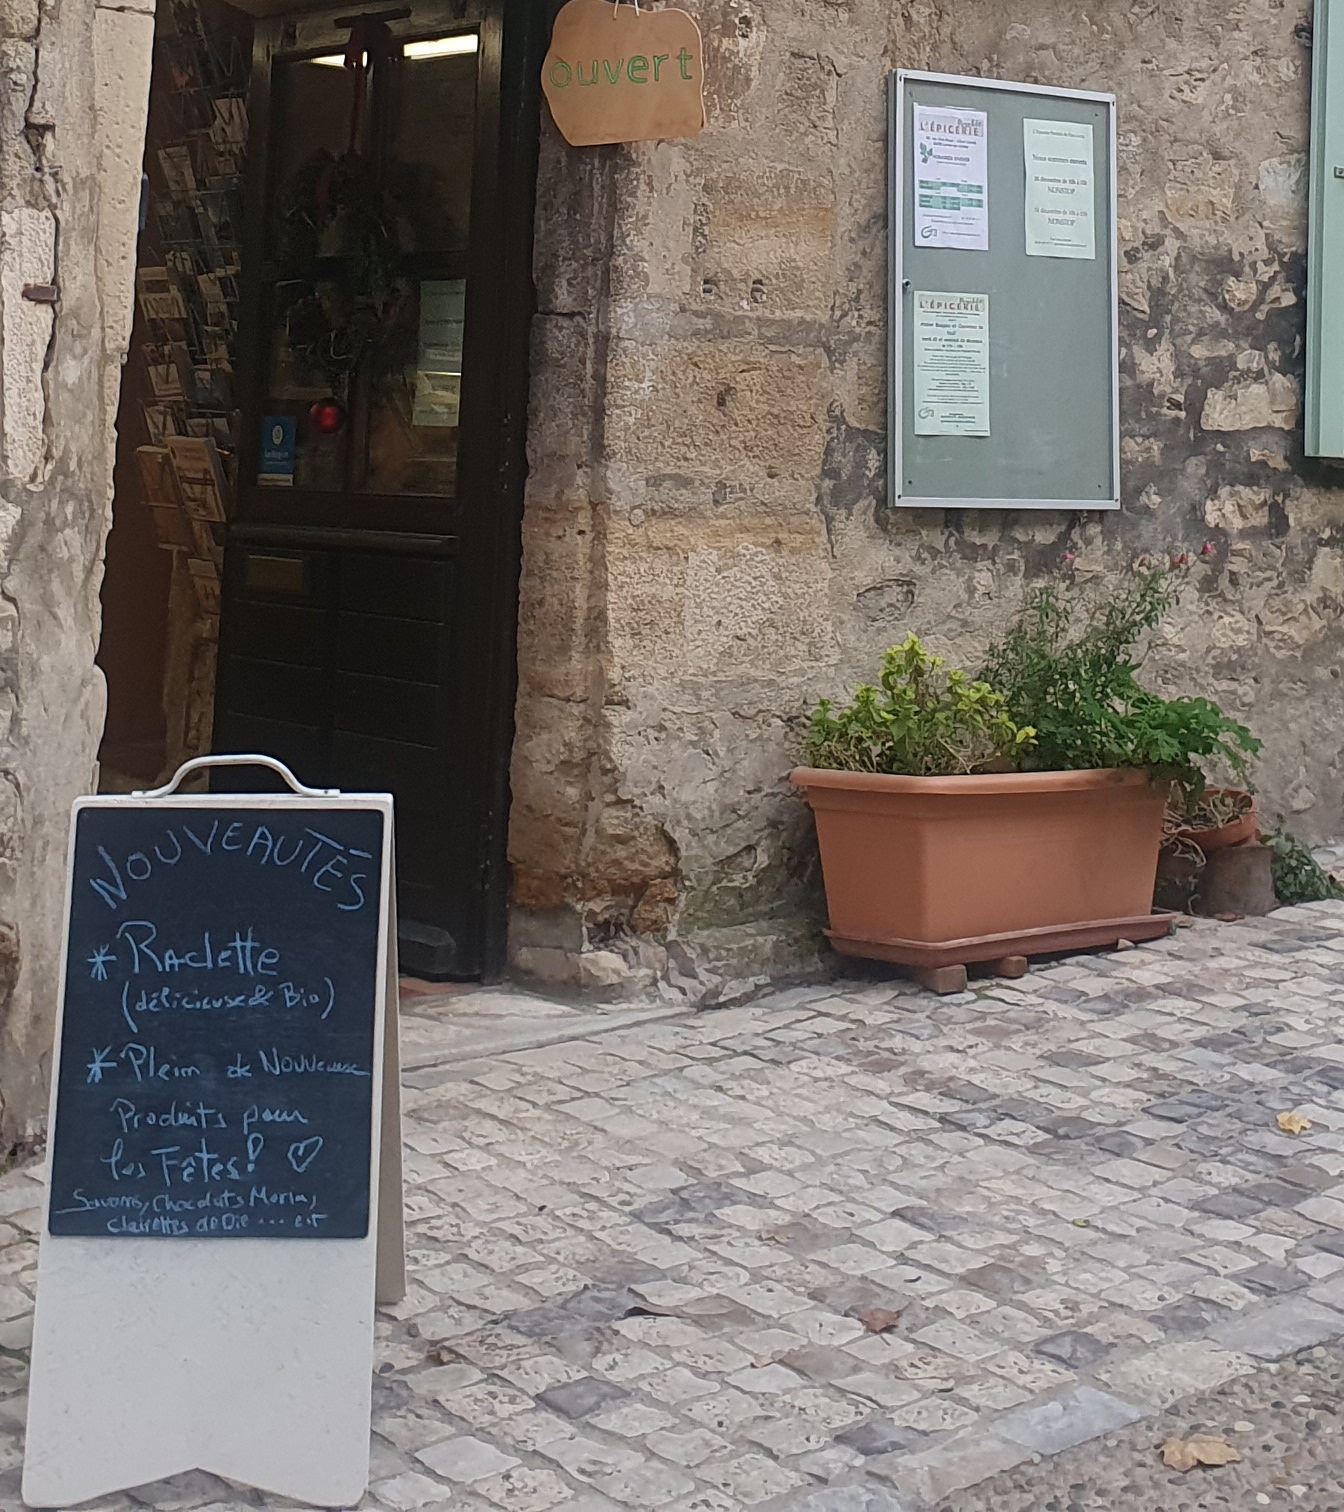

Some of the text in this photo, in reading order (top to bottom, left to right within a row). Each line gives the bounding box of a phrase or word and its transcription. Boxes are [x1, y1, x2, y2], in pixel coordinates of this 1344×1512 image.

[549, 48, 693, 88] ouvert
[89, 819, 373, 911] NOUVEAUTÉS
[227, 1053, 252, 1079] de
[110, 1097, 309, 1135] Produits pour
